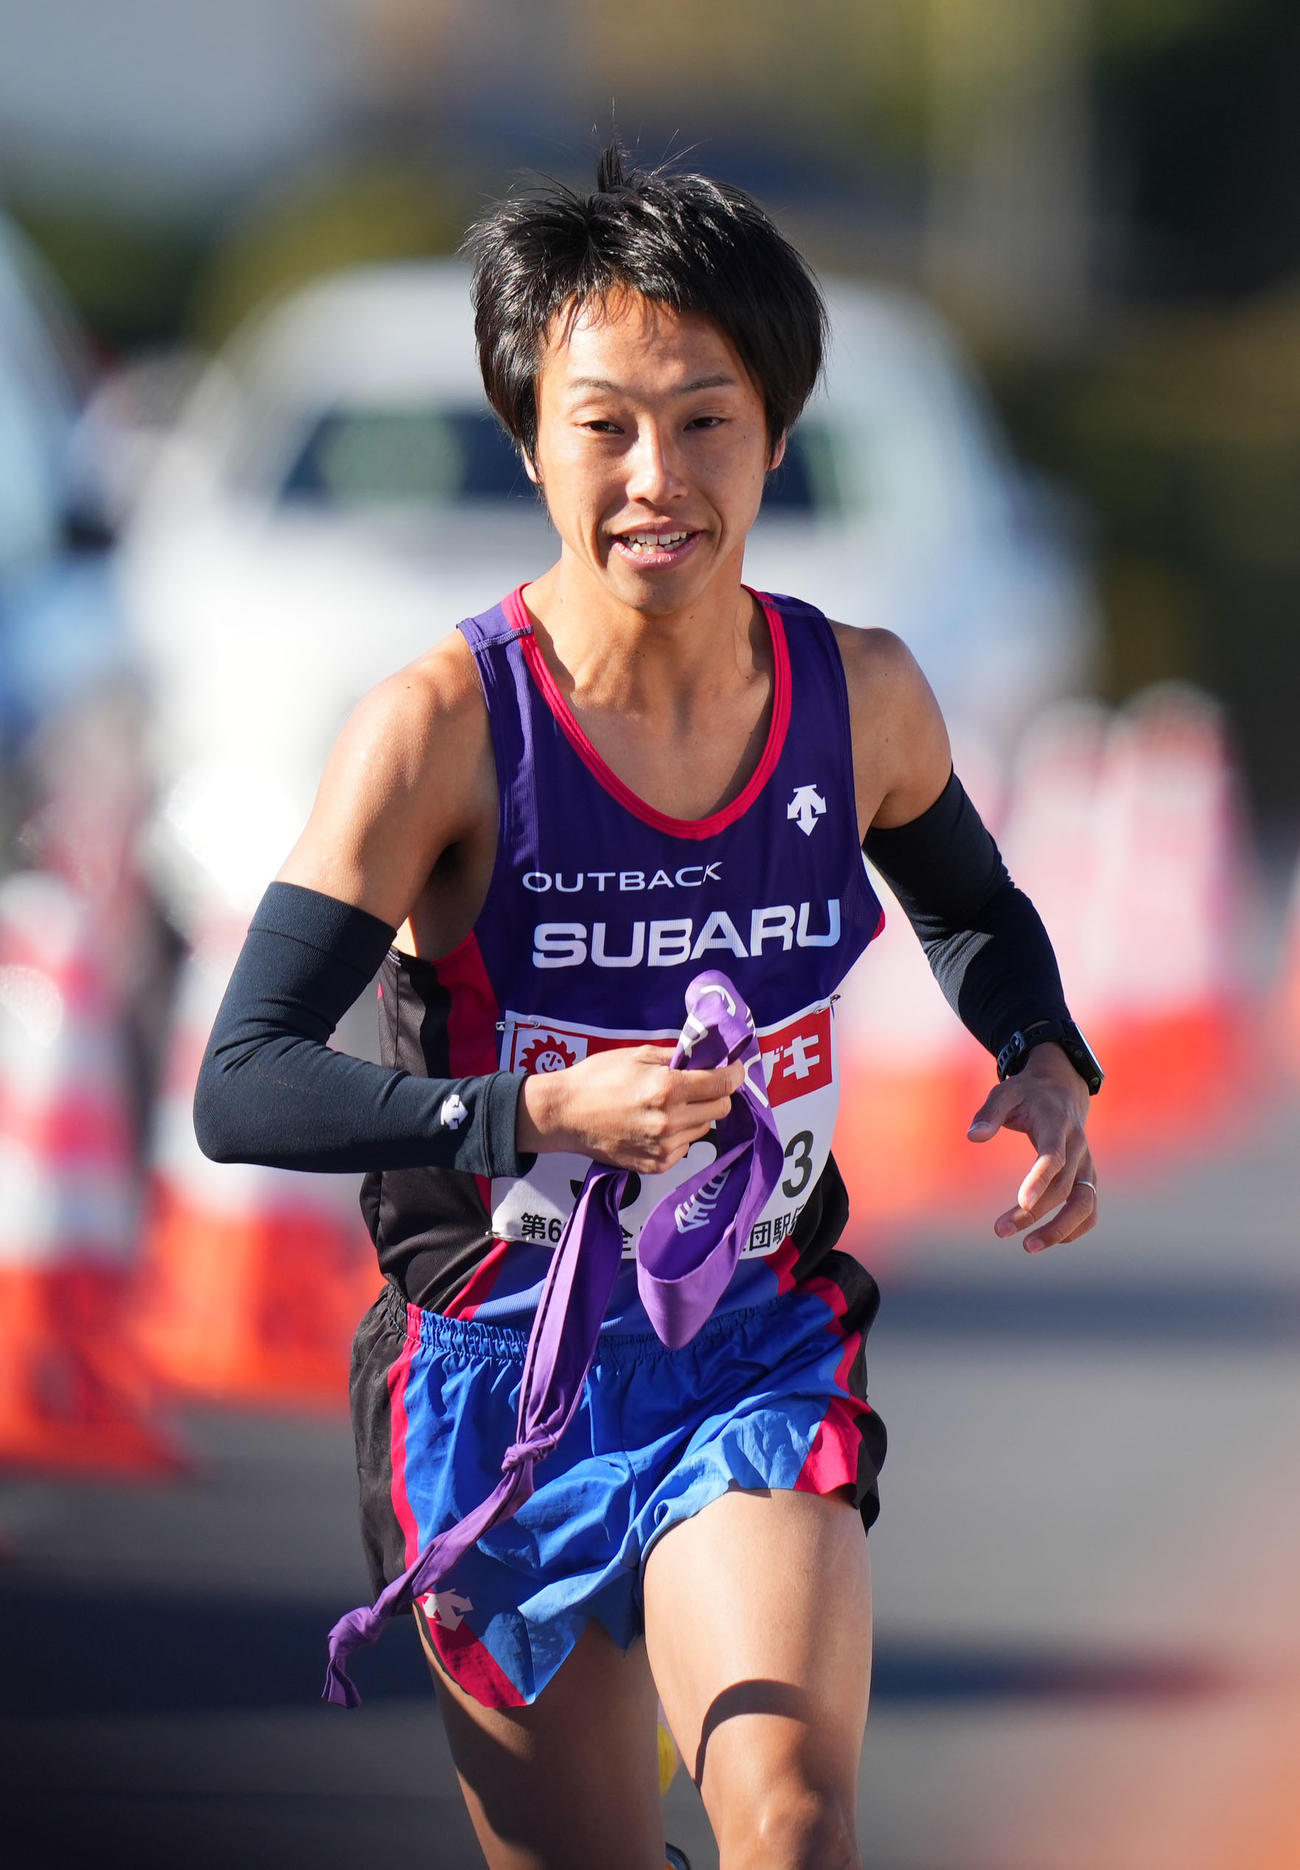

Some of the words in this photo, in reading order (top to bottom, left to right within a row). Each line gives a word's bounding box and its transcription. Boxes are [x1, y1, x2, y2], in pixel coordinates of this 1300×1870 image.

[522, 861, 723, 893] OUTBACK
[532, 898, 841, 969] SUBARU
[782, 1130, 814, 1198] 3
[520, 1211, 567, 1243] 第6
